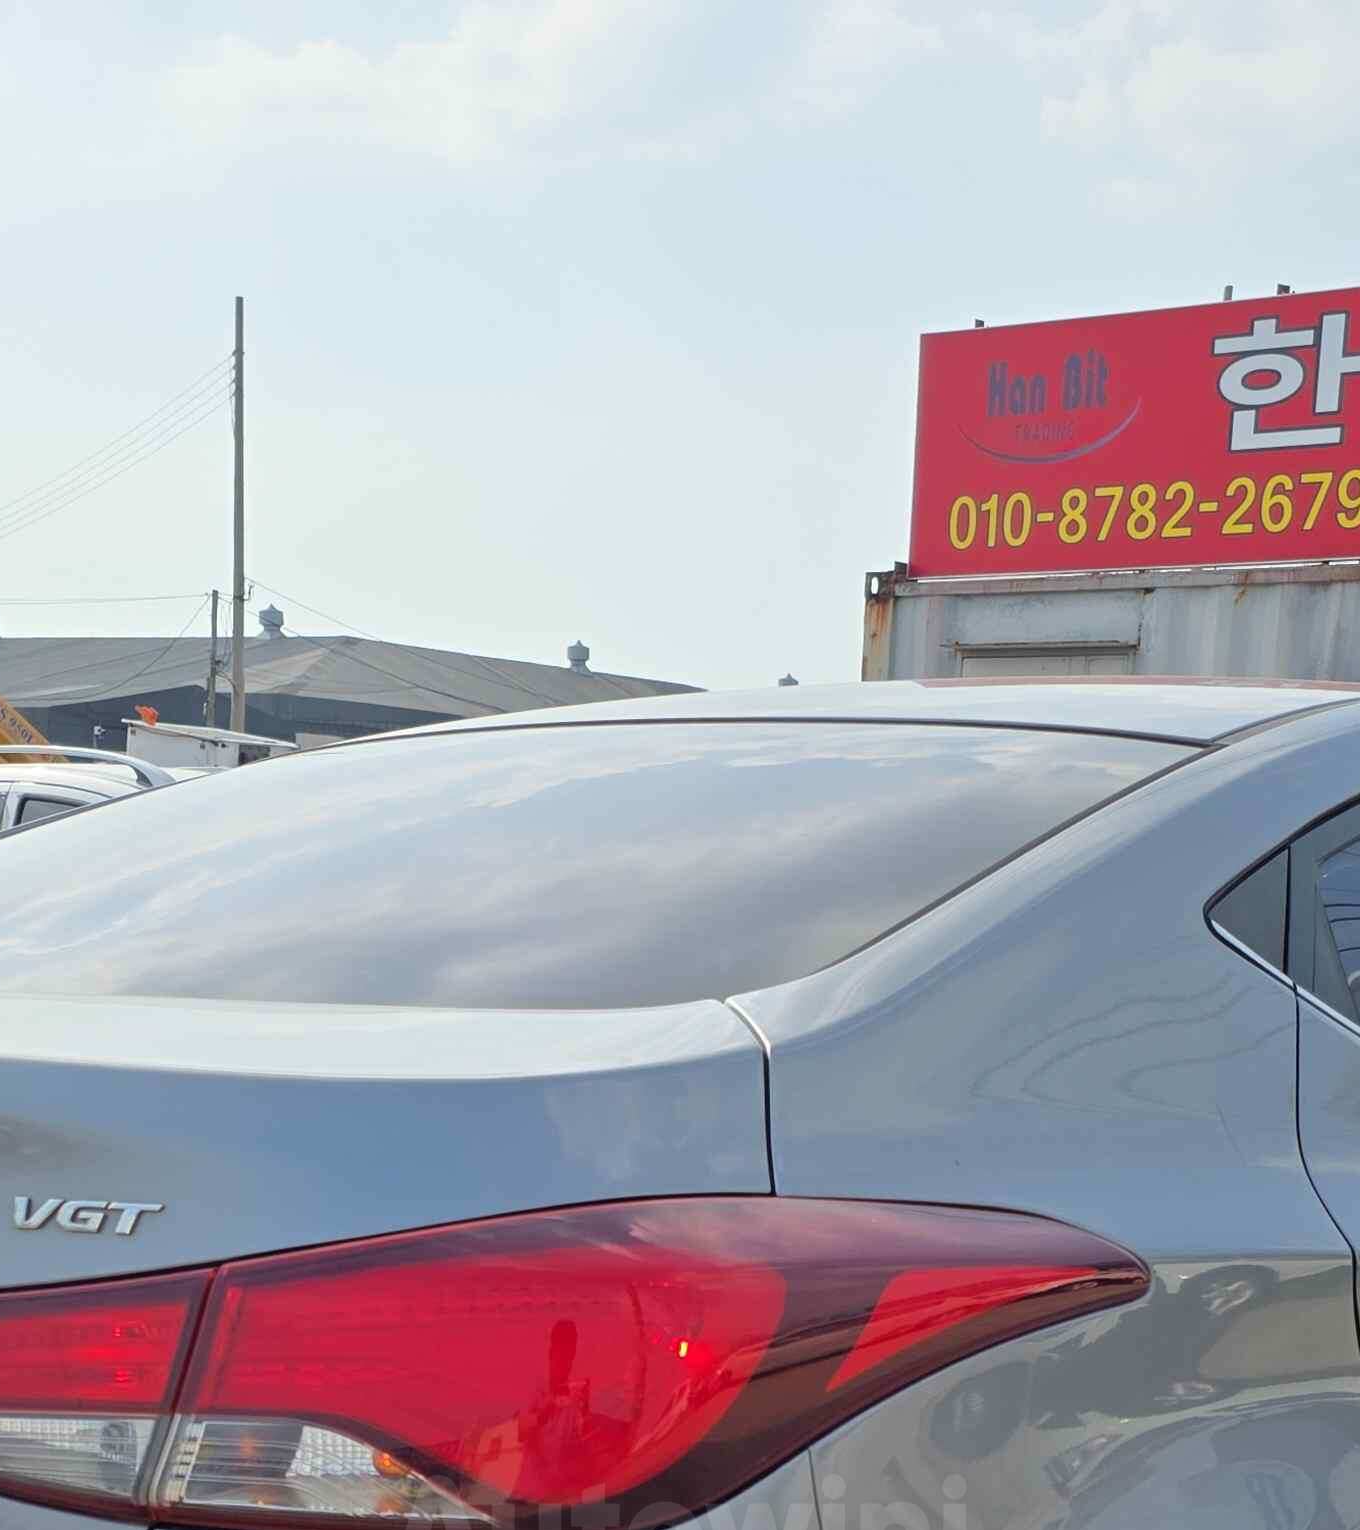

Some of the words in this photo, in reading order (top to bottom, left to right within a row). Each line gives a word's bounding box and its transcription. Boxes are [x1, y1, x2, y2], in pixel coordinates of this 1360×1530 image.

[986, 361, 1046, 417] Han
[1062, 348, 1110, 411] Bit
[13, 1195, 165, 1236] VGT
